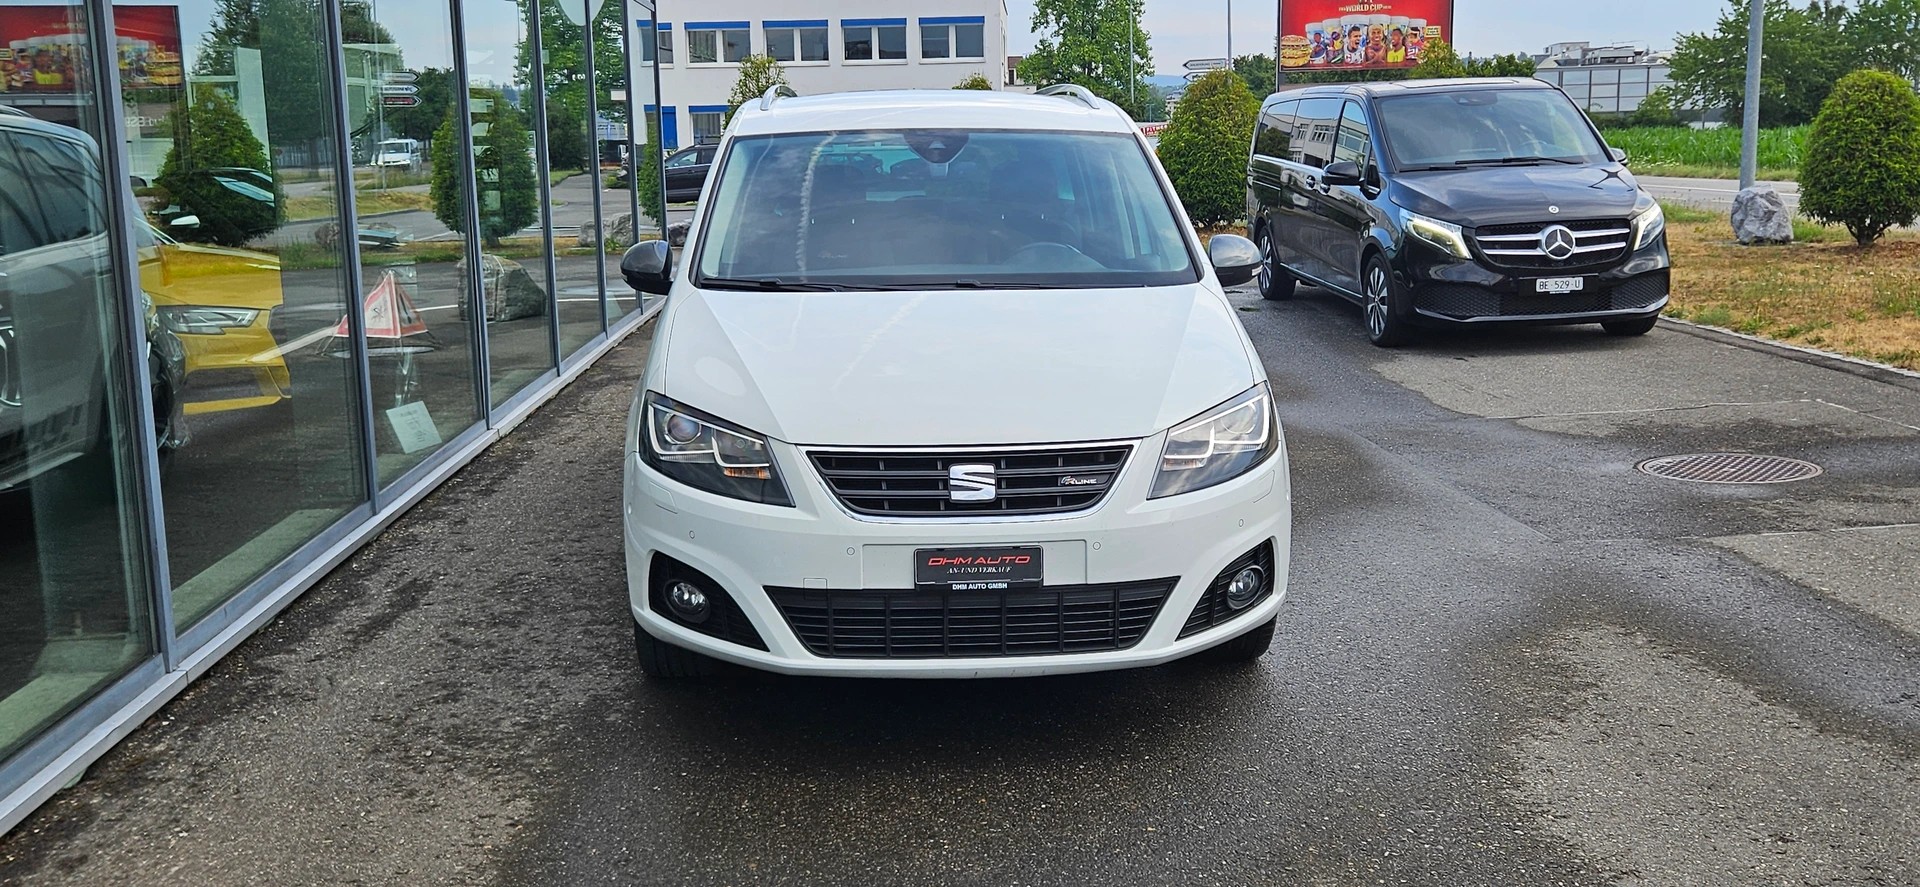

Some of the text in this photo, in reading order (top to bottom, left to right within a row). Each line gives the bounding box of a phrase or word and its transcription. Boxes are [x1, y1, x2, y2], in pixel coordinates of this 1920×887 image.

[1346, 4, 1369, 12] WORLD
[1539, 279, 1580, 290] BE 529 U
[928, 555, 1031, 566] DHM AUTO
